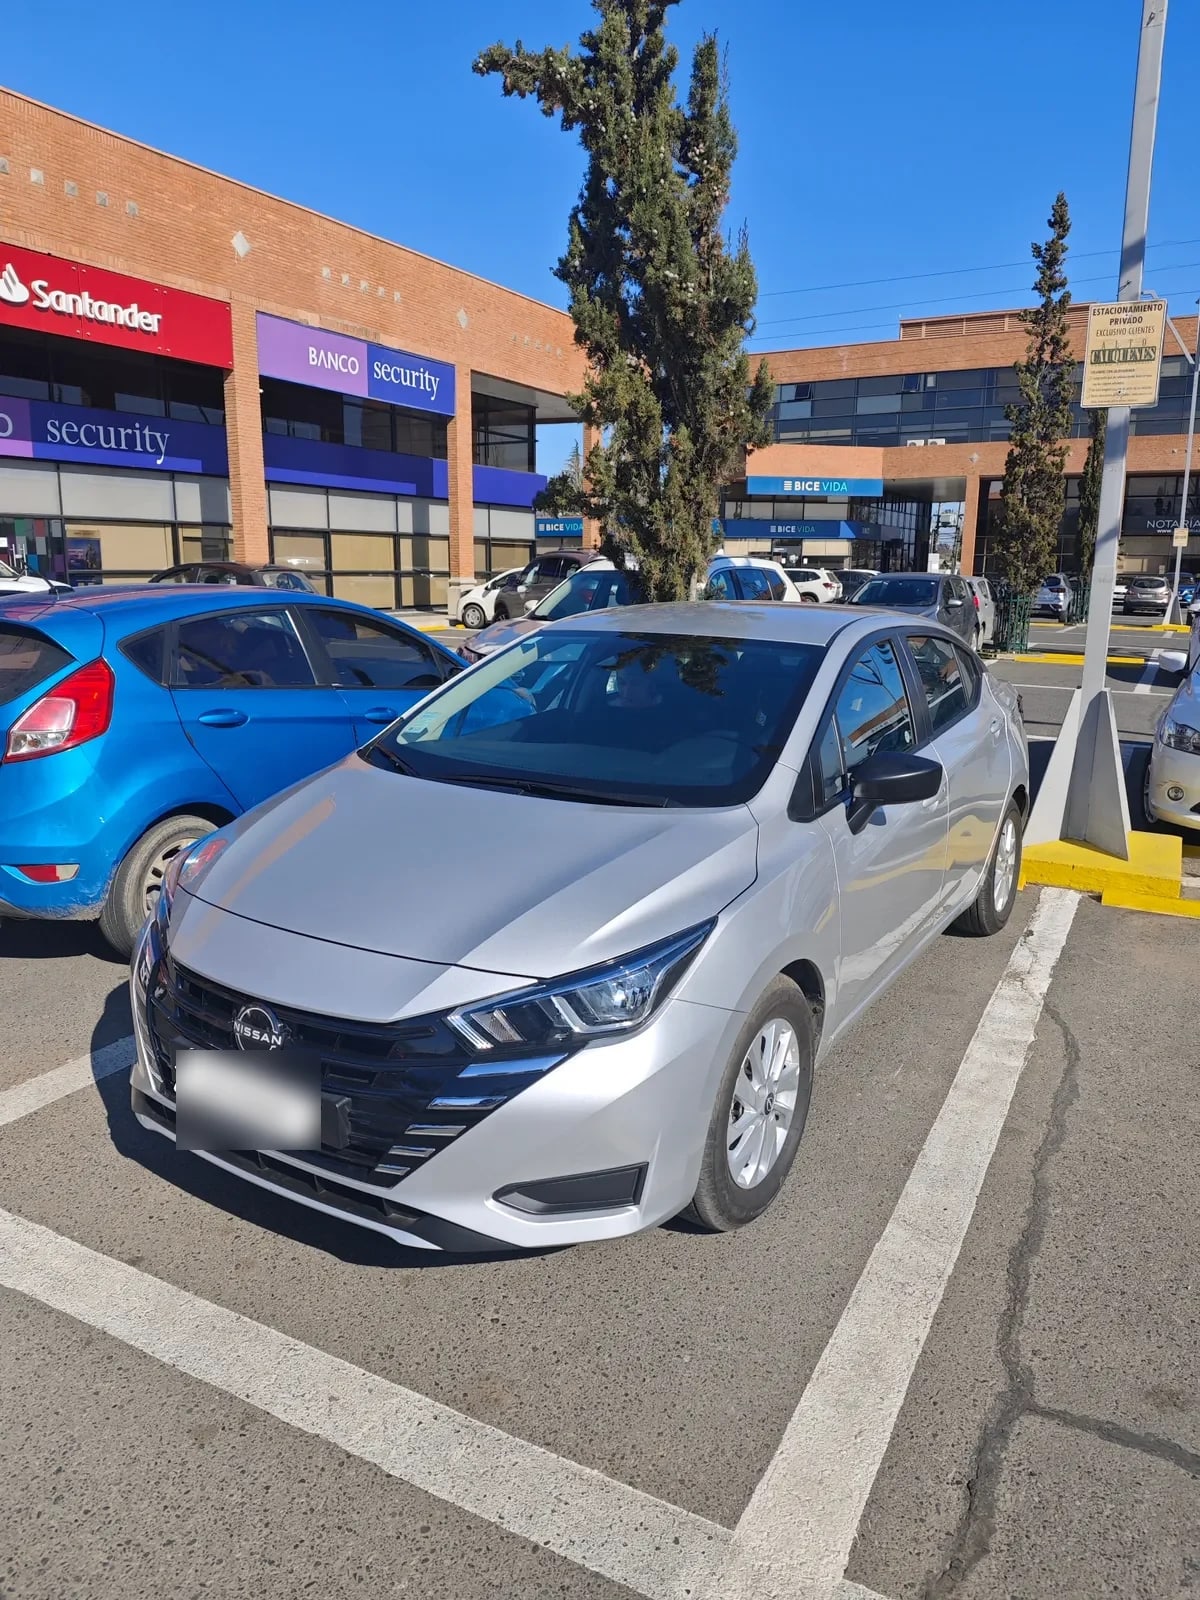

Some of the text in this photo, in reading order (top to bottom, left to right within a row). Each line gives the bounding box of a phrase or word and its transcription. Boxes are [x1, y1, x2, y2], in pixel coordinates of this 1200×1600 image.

[31, 279, 162, 333] Santander
[1092, 303, 1163, 316] ESTACIONAMIENTO
[1109, 316, 1143, 325] PRIVADO
[1095, 326, 1155, 337] EXCLUSIVO CLIENTES
[308, 346, 440, 401] BANCO security
[46, 418, 170, 465] security
[794, 481, 848, 492] BICE VIDA
[545, 523, 584, 531] BICE VIDA
[796, 525, 815, 533] VIDA
[233, 1020, 283, 1046] NISSAN
